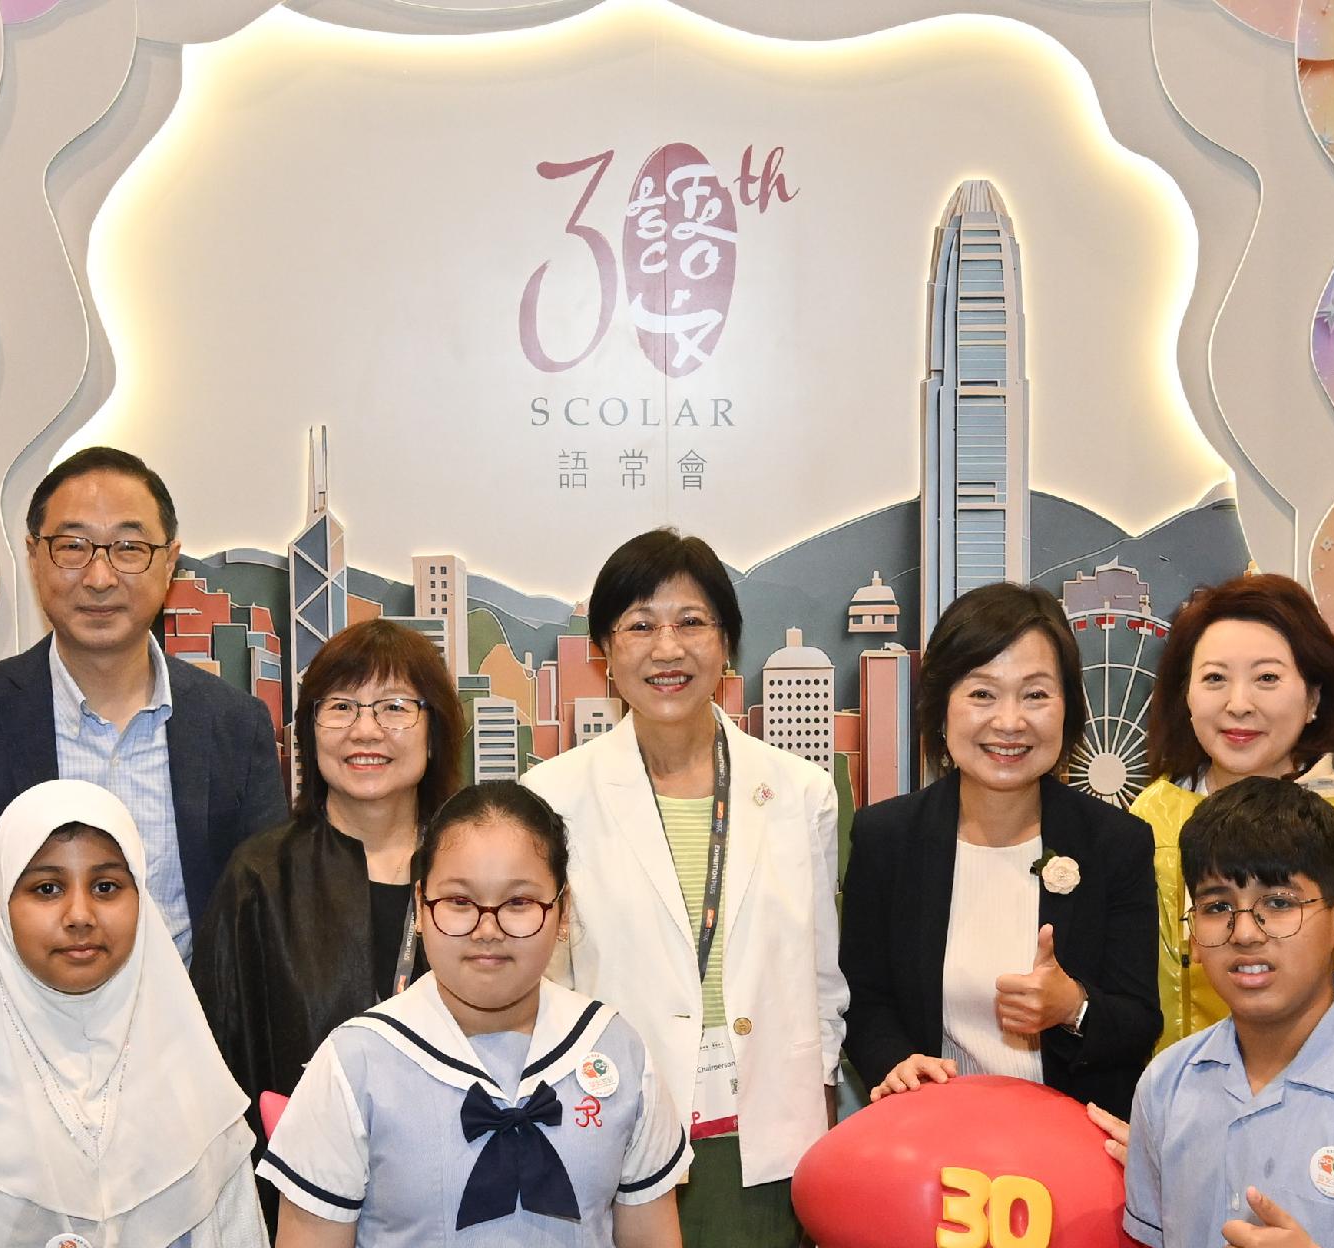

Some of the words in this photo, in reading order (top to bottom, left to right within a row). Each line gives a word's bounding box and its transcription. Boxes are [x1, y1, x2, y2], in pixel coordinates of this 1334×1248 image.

[530, 397, 737, 427] SCOLAR
[558, 449, 708, 490] 語常會
[697, 1061, 736, 1074] Chairperson
